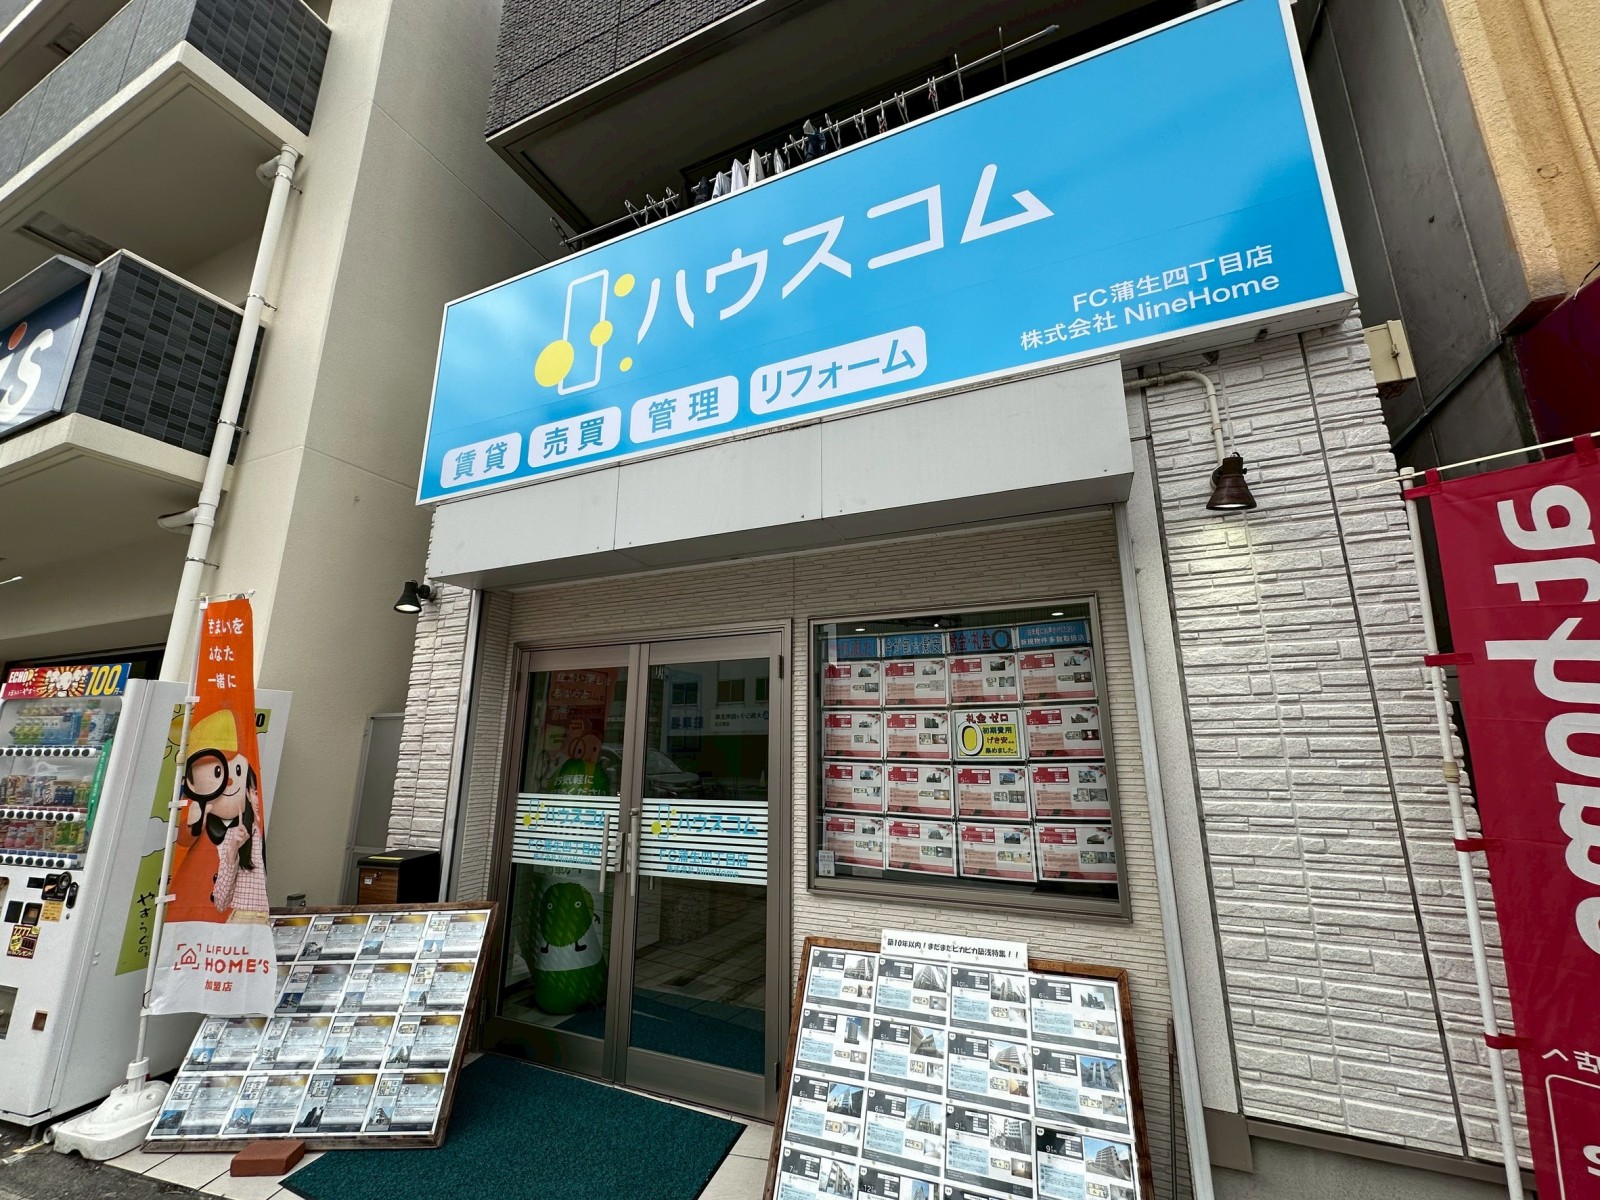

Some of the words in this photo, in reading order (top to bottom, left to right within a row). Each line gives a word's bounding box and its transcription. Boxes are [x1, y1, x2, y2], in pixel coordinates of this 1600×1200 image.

[637, 163, 1055, 344] ハウスコム
[1072, 244, 1274, 312] FC蒲生四丁目店
[1020, 312, 1118, 351] 株式会社
[1125, 273, 1281, 326] NineHome
[761, 339, 917, 404] リフォーム
[648, 387, 721, 434] 管理
[543, 414, 606, 459] 売買
[455, 442, 508, 482] 賃貸
[966, 713, 987, 724] 礼金
[989, 713, 1009, 723] ゼロ
[677, 813, 758, 835] ハウスコム
[660, 848, 749, 867] FC蒲生四丁目店
[205, 957, 270, 975] HOME'S
[206, 944, 250, 956] LIFULL
[204, 979, 234, 992] 加盟店
